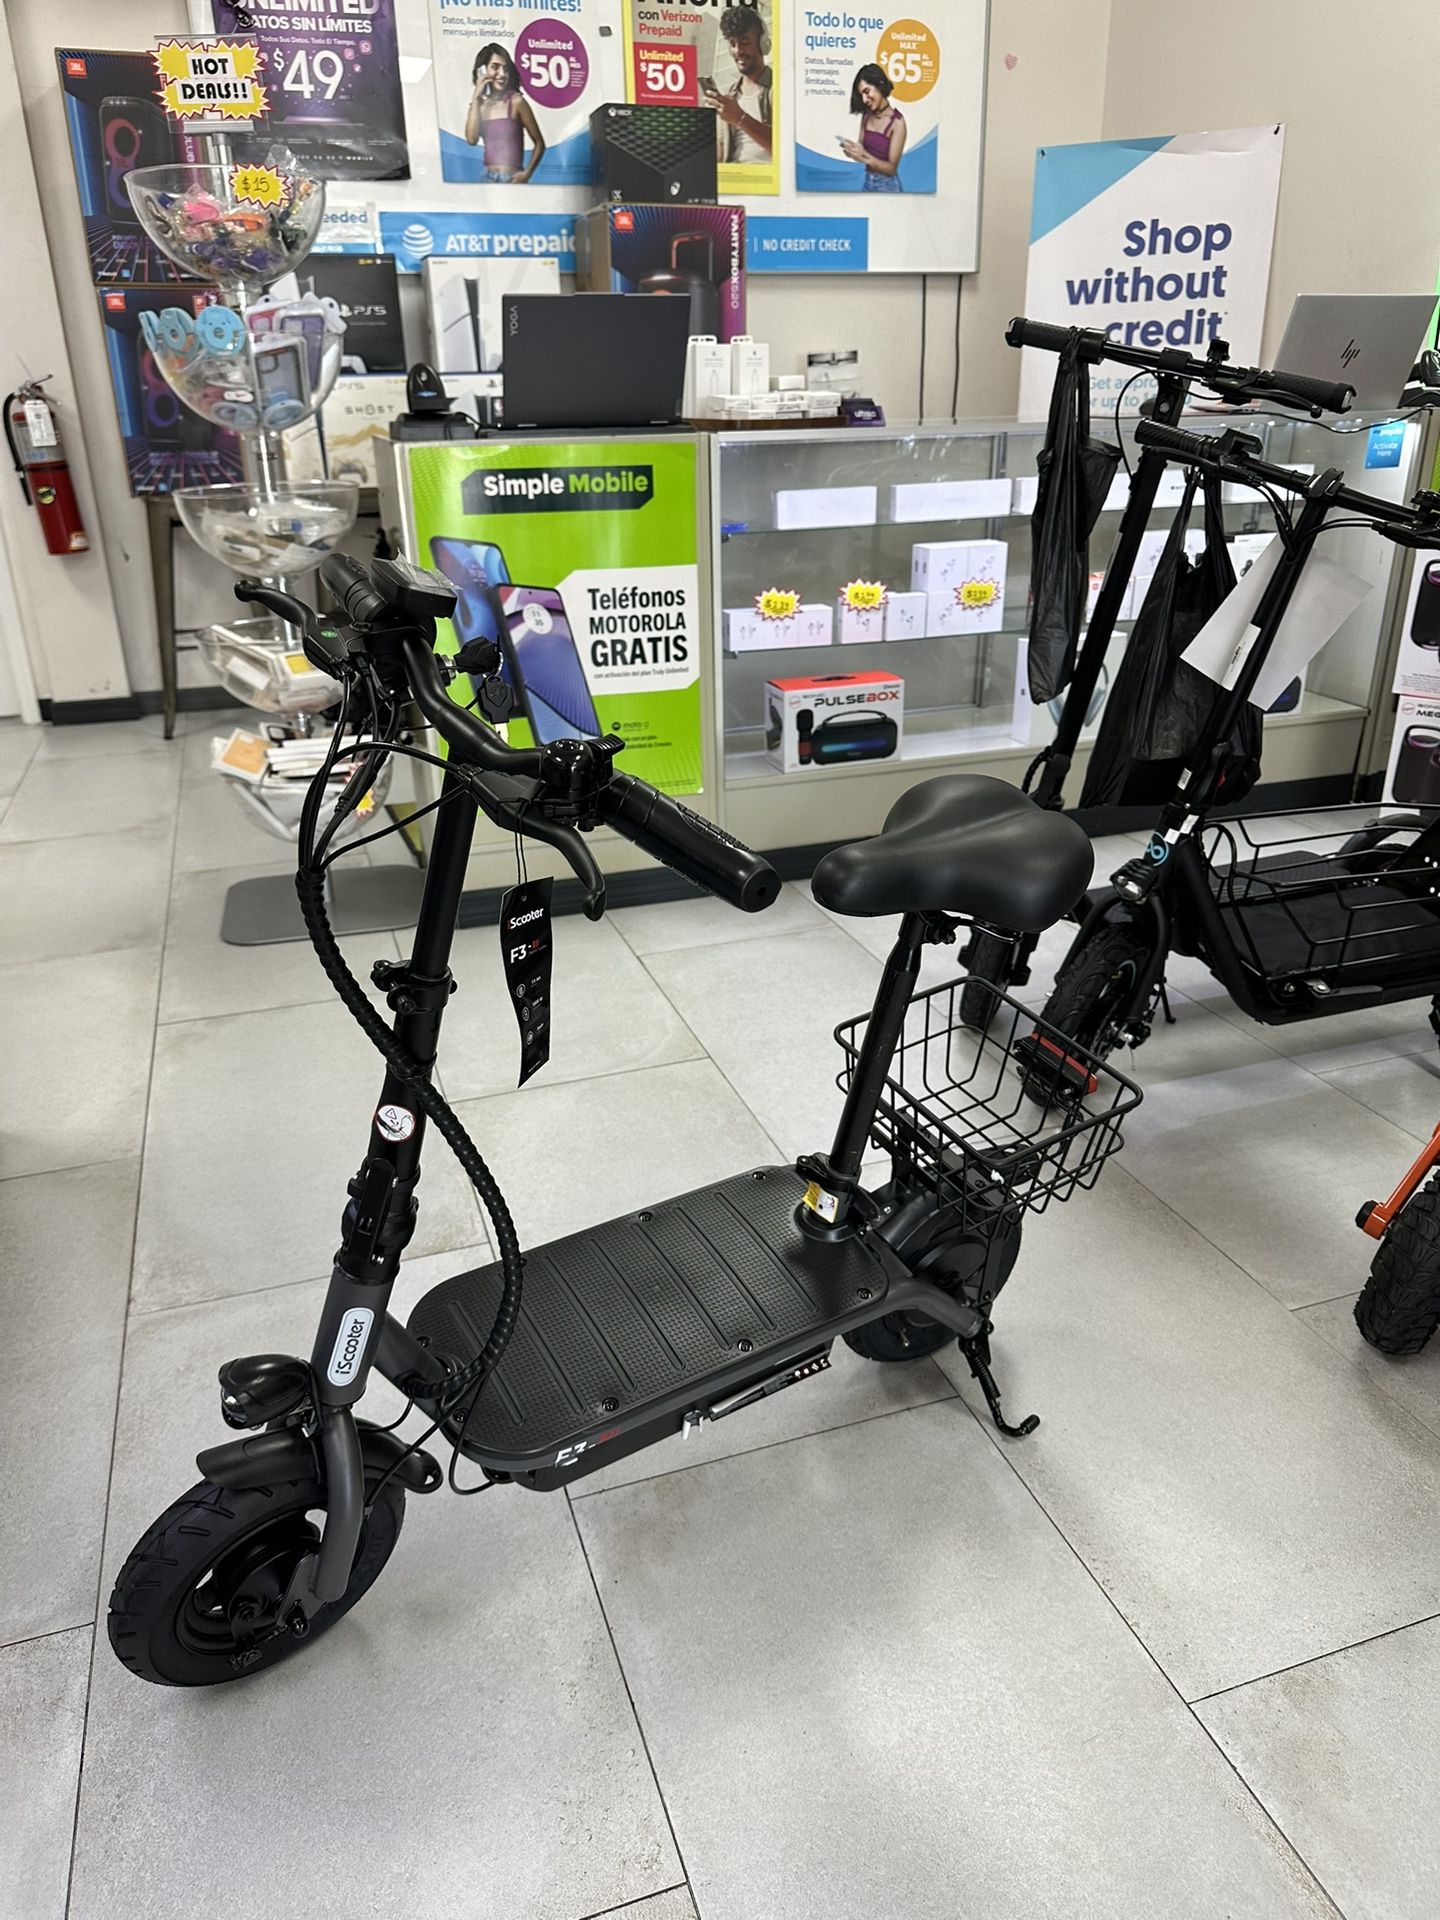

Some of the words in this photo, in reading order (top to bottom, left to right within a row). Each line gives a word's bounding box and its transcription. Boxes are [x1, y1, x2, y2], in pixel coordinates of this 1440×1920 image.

[238, 0, 380, 15] NLIMITED
[638, 11, 659, 20] con
[661, 9, 702, 23] Verizon
[252, 15, 289, 30] ATOS
[291, 17, 316, 31] SIN
[318, 15, 373, 34] LÍMITES
[442, 16, 465, 25] Datos,
[467, 16, 500, 26] llamadas
[806, 11, 840, 27] Todo
[843, 13, 855, 28] lo
[858, 16, 884, 32] que
[443, 29, 478, 38] mensajes
[480, 28, 516, 38] ilimitados
[639, 23, 682, 37] Prepaid
[891, 32, 927, 42] Unlimited
[528, 39, 573, 50] Unlimited
[805, 33, 856, 50] quieres
[639, 50, 684, 62] Unlimited
[191, 58, 229, 75] HOT
[273, 48, 344, 100] $49
[521, 53, 570, 89] $50
[880, 51, 922, 84] $65
[640, 62, 685, 92] $50
[181, 83, 249, 99] DEALS!!
[242, 178, 270, 195] $15
[322, 211, 368, 224] eeded
[445, 234, 491, 252] AT&T
[763, 238, 778, 251] NO
[780, 239, 816, 251] CREDIT
[818, 239, 851, 252] CHECK
[1123, 219, 1232, 261] Shop
[1066, 265, 1227, 305] without
[353, 305, 387, 316] PS5
[1106, 309, 1223, 347] credit
[1090, 377, 1110, 390] Get
[1125, 393, 1139, 407] to
[484, 474, 565, 500] Simple
[569, 472, 649, 493] Mobile
[588, 587, 686, 611] Teléfonos
[589, 612, 687, 635] MOTOROLA
[591, 634, 688, 667] GRATIS
[814, 691, 899, 707] PULSEBOX
[507, 908, 544, 930] iScooter
[335, 1317, 365, 1376] iScooter
